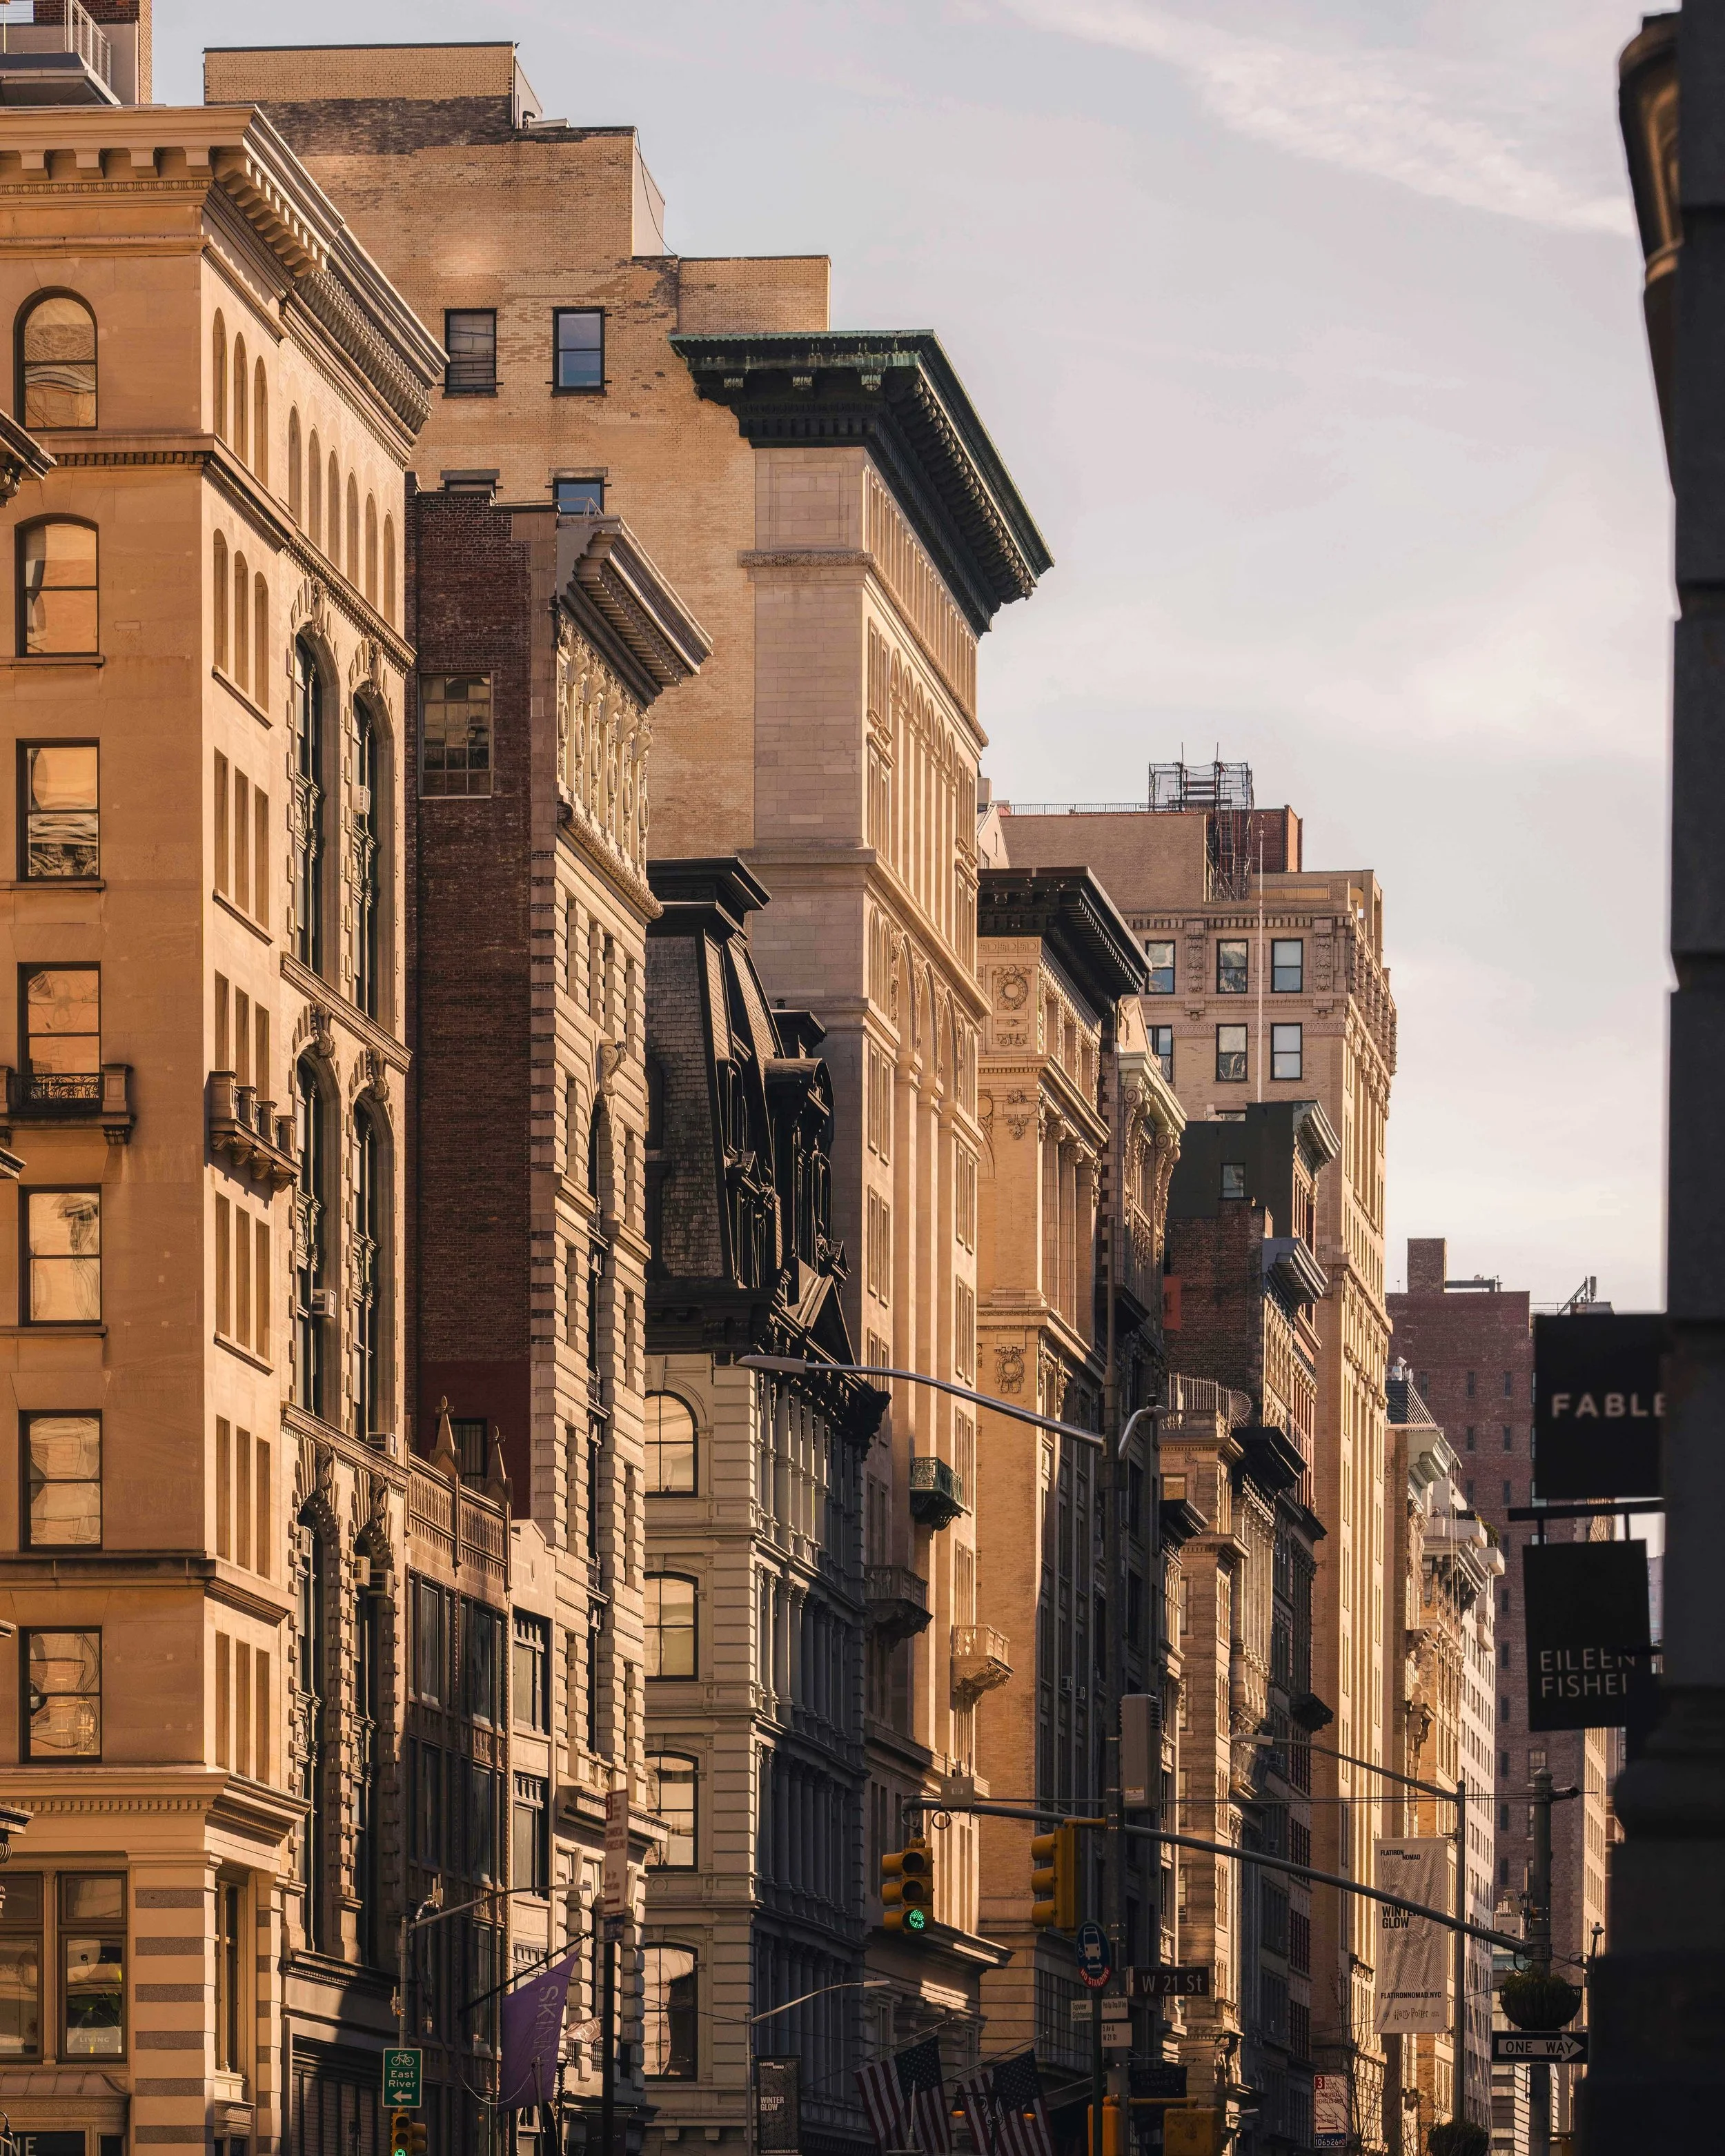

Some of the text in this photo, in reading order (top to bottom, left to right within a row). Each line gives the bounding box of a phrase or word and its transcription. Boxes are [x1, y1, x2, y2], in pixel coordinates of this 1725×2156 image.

[1541, 1673, 1626, 1698] FISHE
[1382, 1917, 1409, 1928] GLOW
[1080, 1967, 1110, 1987] NO STANDING
[1142, 1974, 1203, 1992] W 21 St
[1072, 2011, 1093, 2020] Sightseeing
[1393, 2008, 1429, 2020] Harry Potter
[1506, 2041, 1574, 2054] ONE WAY
[388, 2079, 416, 2088] River
[1317, 2077, 1323, 2089] 3
[1, 2137, 37, 2156] NE
